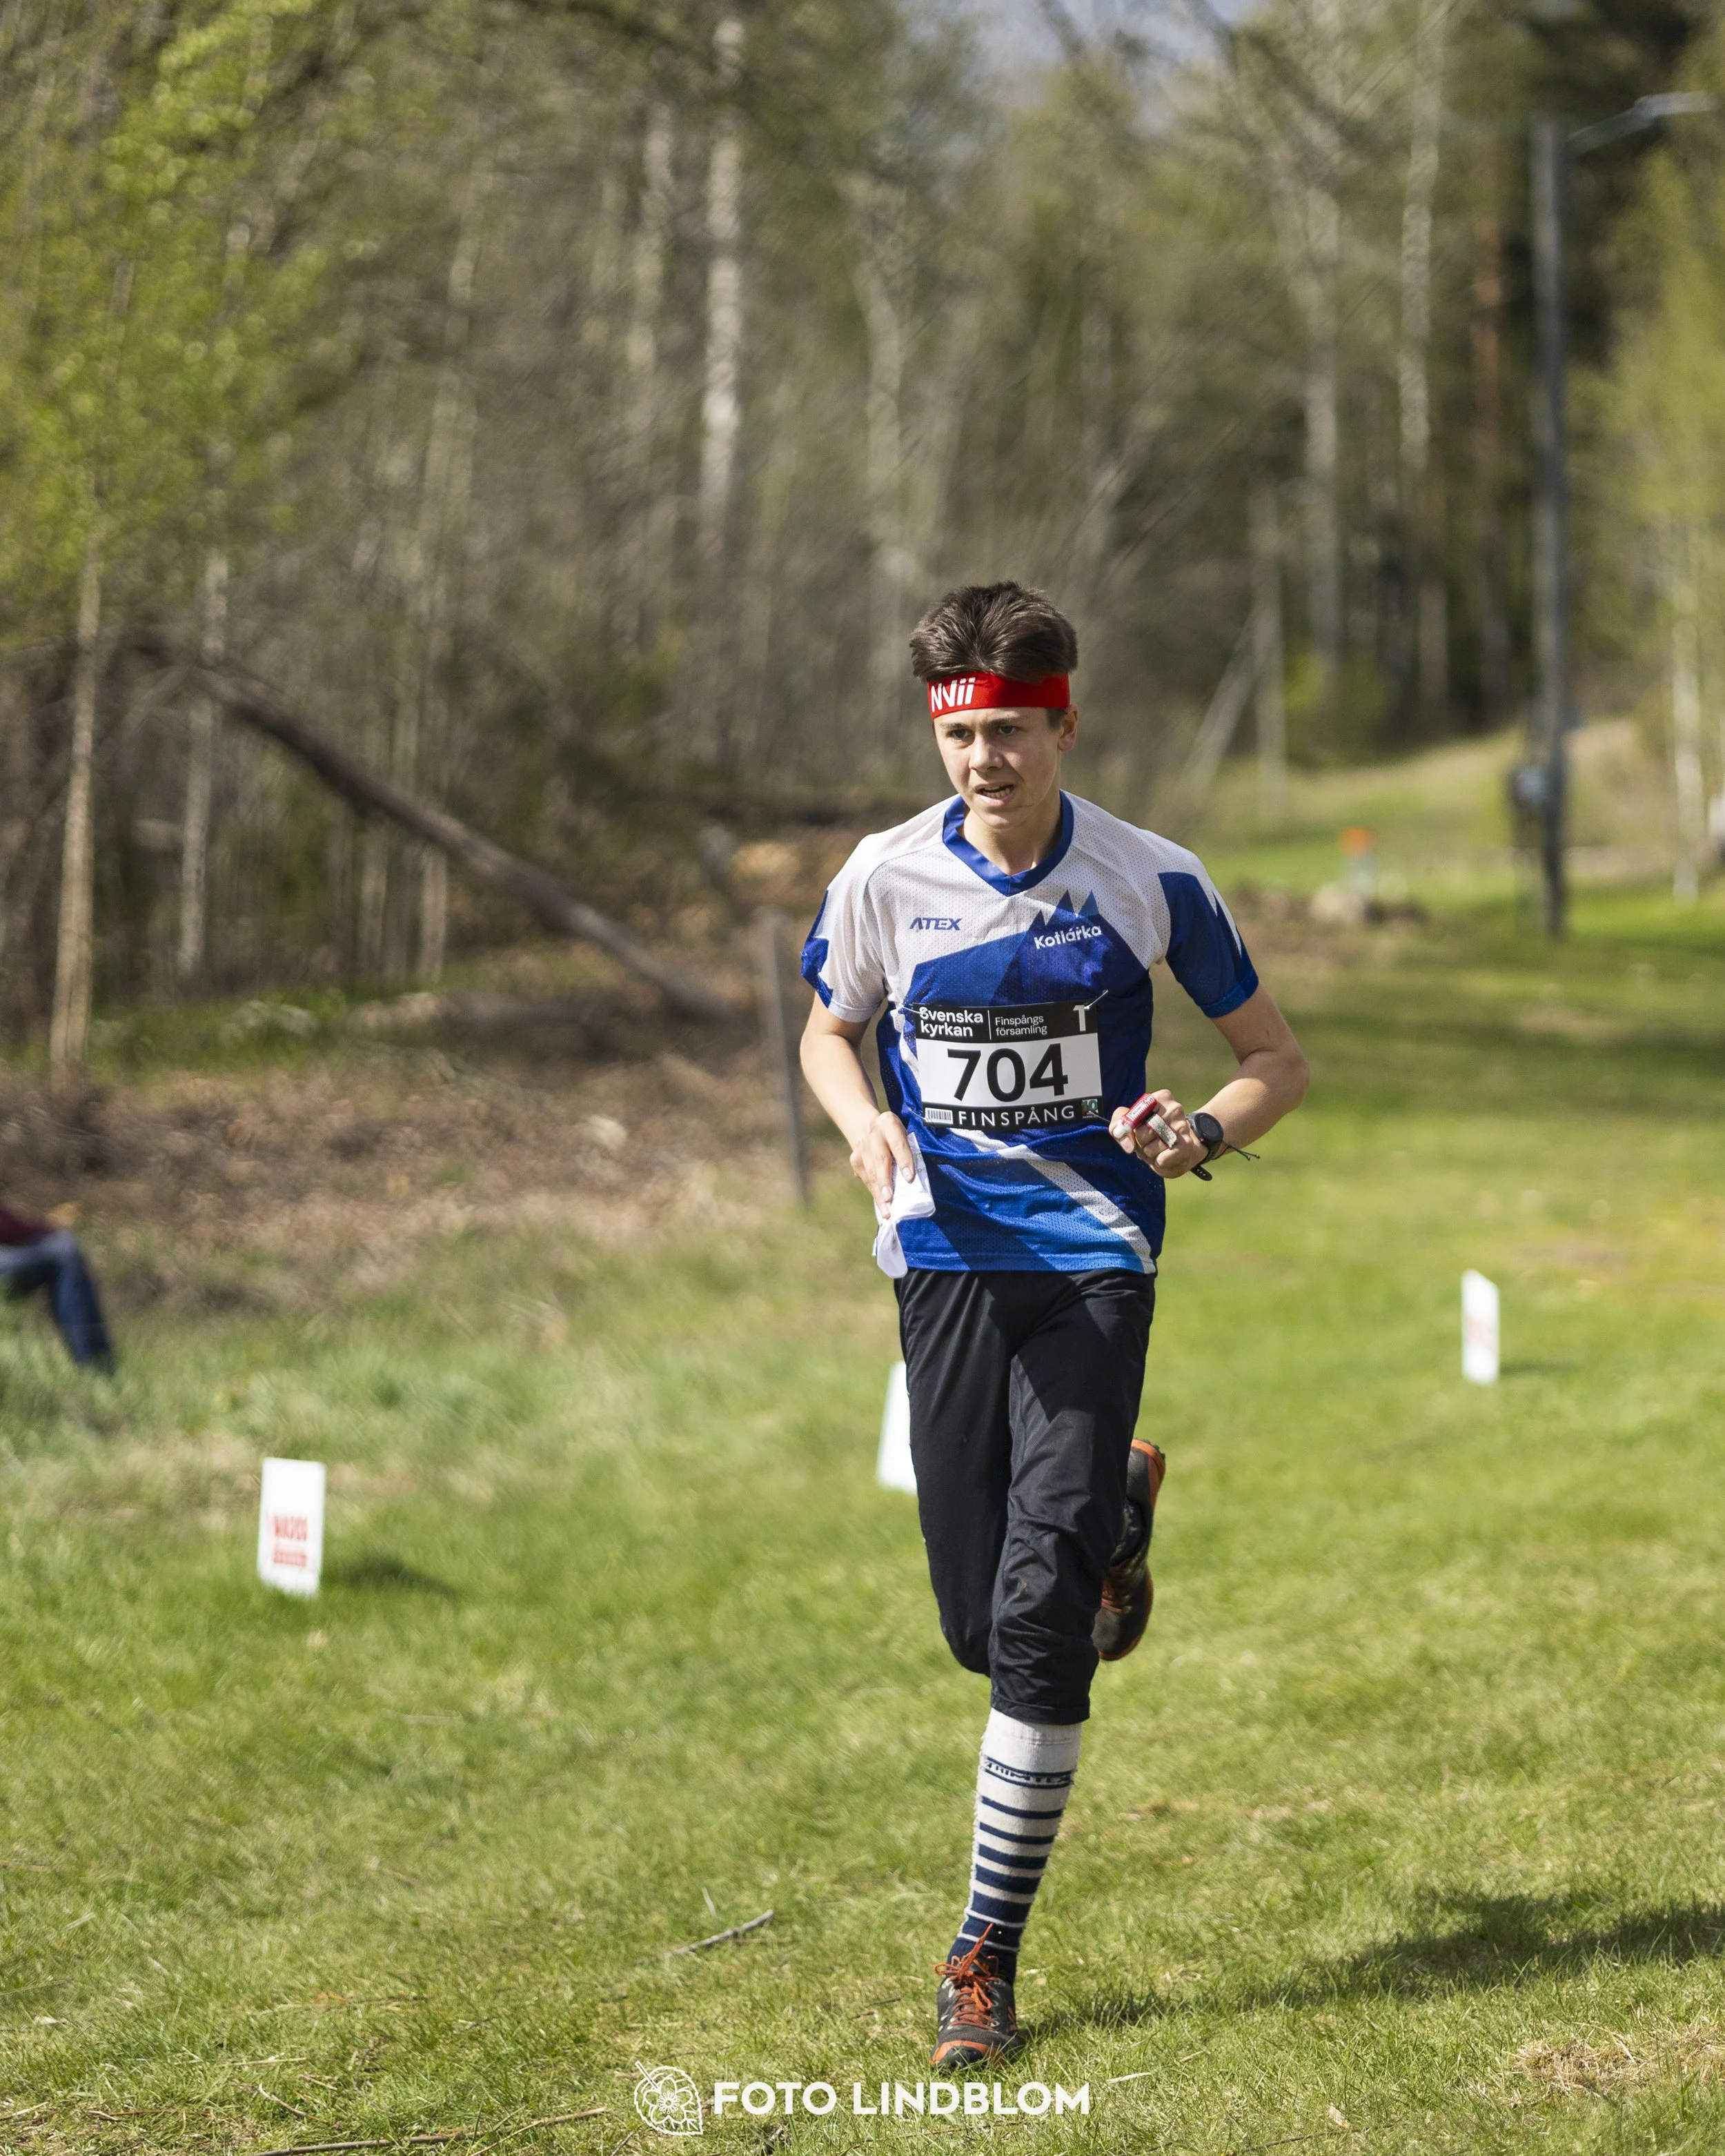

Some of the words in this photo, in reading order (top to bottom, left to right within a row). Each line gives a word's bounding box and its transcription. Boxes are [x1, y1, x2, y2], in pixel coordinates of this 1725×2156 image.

[909, 917, 963, 931] ATEX
[919, 1007, 984, 1023] Svenska
[995, 1014, 1044, 1027] Finspångs
[920, 1020, 974, 1037] kyrkan
[996, 1025, 1047, 1036] församling
[947, 1042, 1069, 1102] 704
[958, 1105, 1075, 1127] FINSPÅNG
